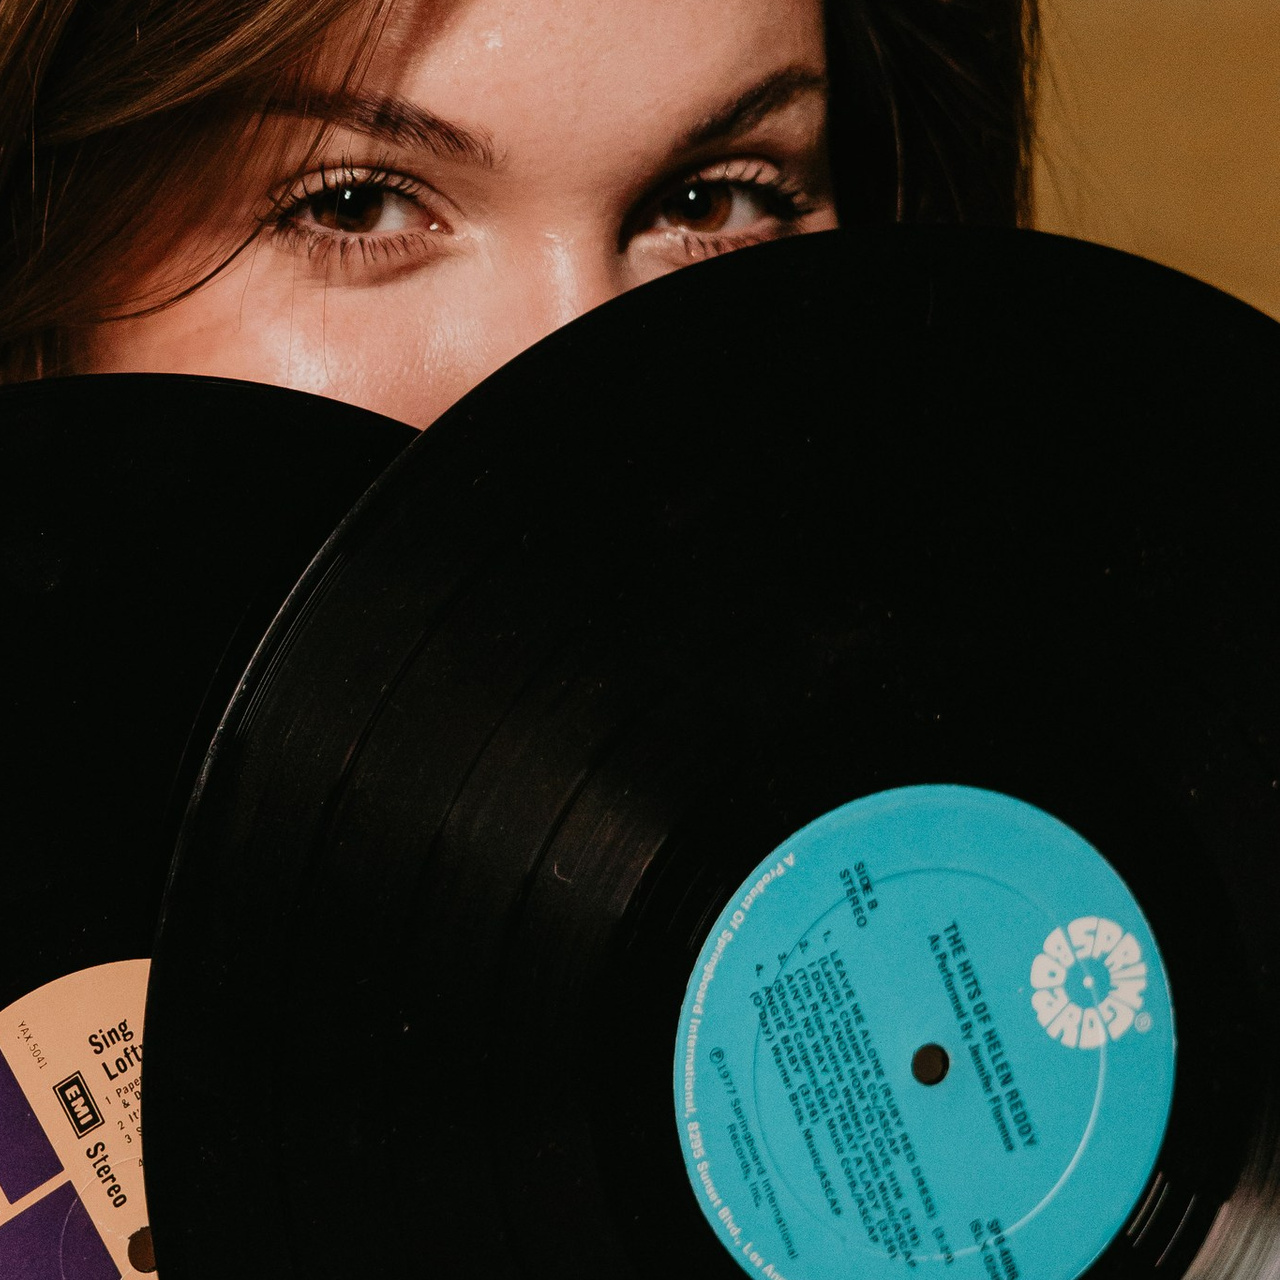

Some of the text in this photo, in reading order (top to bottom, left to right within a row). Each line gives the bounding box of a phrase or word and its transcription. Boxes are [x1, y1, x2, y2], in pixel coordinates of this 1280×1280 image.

[741, 863, 785, 910] Product
[783, 852, 795, 866] A
[853, 860, 879, 911] SIDE B
[730, 910, 744, 931] Of
[839, 868, 867, 928] STEREO
[693, 929, 733, 1014] Springboard
[18, 1020, 47, 1069] YAX.5041
[88, 1019, 134, 1055] Sing
[762, 986, 785, 1032] ANGIE
[780, 1034, 802, 1073] BABY
[817, 956, 843, 1007] (Laurie)
[839, 1010, 866, 1065] Chappell
[861, 1069, 870, 1080] &
[927, 934, 1015, 1153] As Performed By Jennifer Florence
[943, 920, 1037, 1146] THE HITS OF HELEN REDDY
[101, 1044, 142, 1082] Loft
[684, 1019, 701, 1118] International,
[773, 978, 797, 1029] (Shock)
[826, 1117, 844, 1155] Music
[794, 967, 812, 998] (Tim
[842, 1085, 866, 1139] Webber)
[796, 939, 809, 954] 2.
[811, 970, 834, 1014] DON'T
[830, 1019, 852, 1063] KNOW
[848, 1067, 866, 1100] HOW
[862, 1104, 875, 1124] TO
[870, 1127, 891, 1168] LOVE
[887, 1170, 903, 1200] HIM
[822, 929, 831, 943] 1.
[829, 949, 855, 1000] LEAVE
[850, 1002, 865, 1025] ME
[860, 1029, 885, 1079] ALONE
[878, 1082, 904, 1127] (RUBY
[899, 1132, 916, 1163] RED
[911, 1165, 936, 1219] DRESS)
[65, 1084, 93, 1125] EMI
[105, 1096, 111, 1105] 1
[122, 1099, 130, 1109] &
[784, 974, 806, 1012] AIN'T
[801, 1016, 815, 1038] NO
[811, 1040, 829, 1073] WAY
[826, 1078, 838, 1099] TO
[834, 1104, 858, 1150] TREAT
[853, 1156, 863, 1167] A
[858, 1169, 880, 1209] LADY
[117, 1120, 125, 1130] 2
[125, 1134, 132, 1144] 3
[687, 1121, 705, 1159] 8295
[770, 1043, 792, 1089] Warner
[788, 1091, 804, 1126] Bros.
[802, 1128, 842, 1216] Music/ASCAP
[86, 1141, 127, 1208] Stereo
[697, 1161, 722, 1208] Sunset
[726, 1123, 761, 1208] Records, Inc.
[730, 1097, 767, 1176] Springboard
[762, 1178, 799, 1260] International
[742, 1242, 764, 1267] Los
